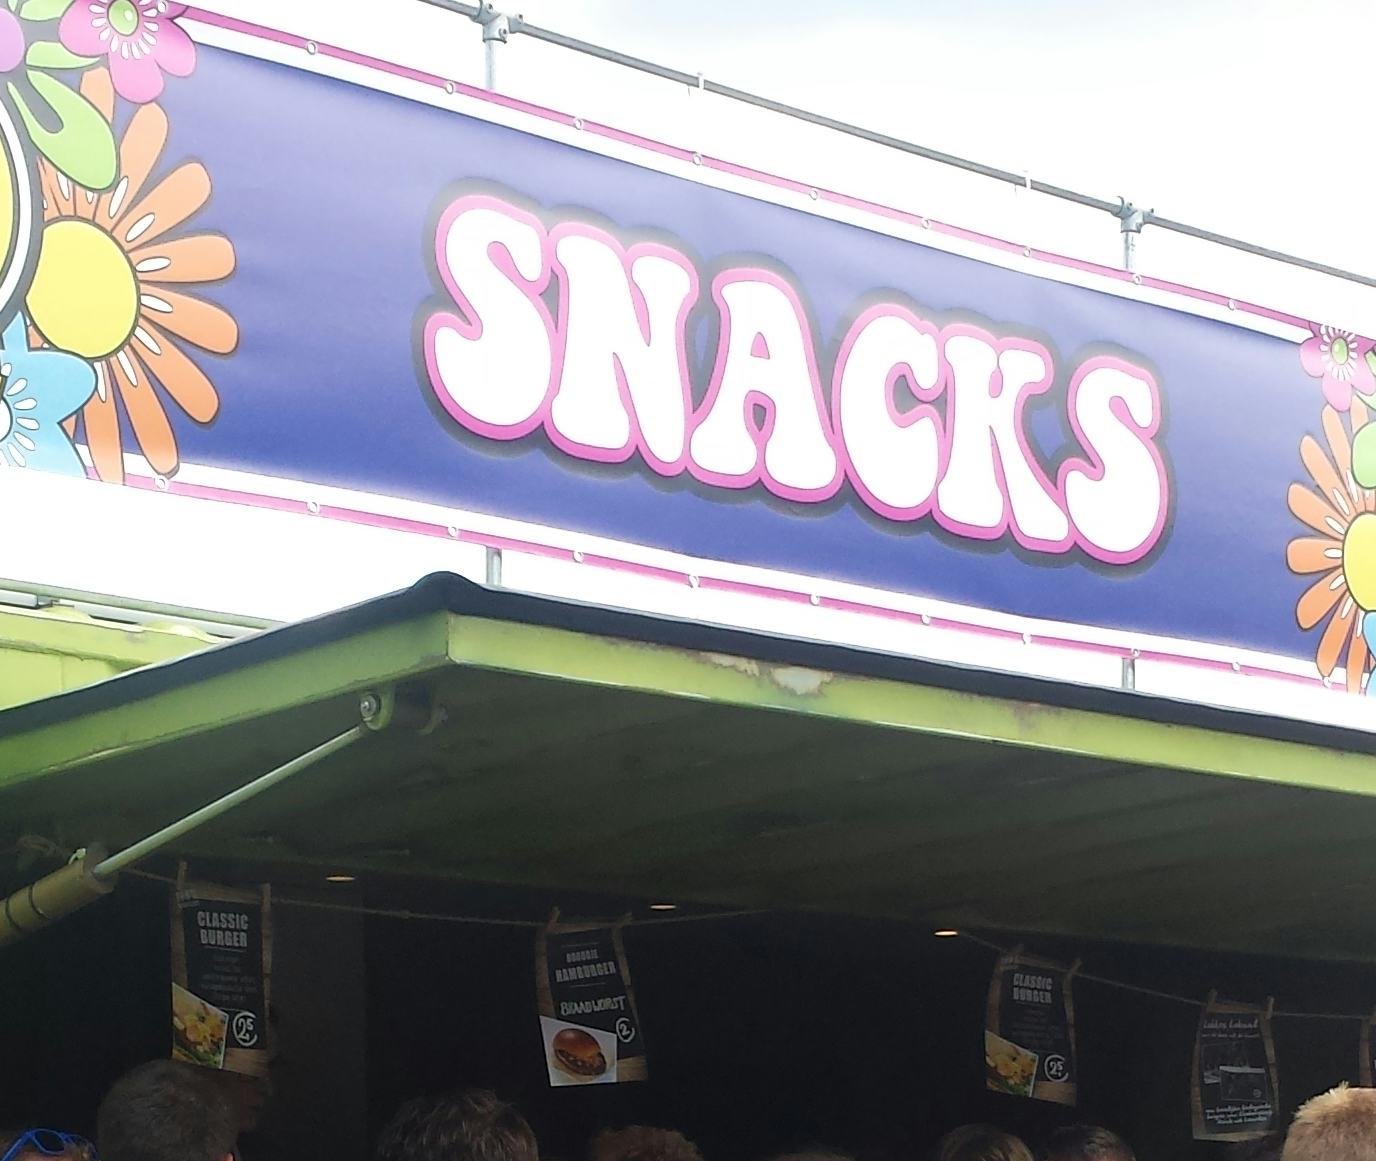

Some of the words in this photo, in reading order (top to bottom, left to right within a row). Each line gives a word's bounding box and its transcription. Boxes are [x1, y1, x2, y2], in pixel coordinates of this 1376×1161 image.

[423, 194, 1169, 566] SNACKS
[197, 911, 249, 931] CLASSIC
[199, 929, 248, 948] BURGER
[555, 961, 617, 984] HAMBURGER
